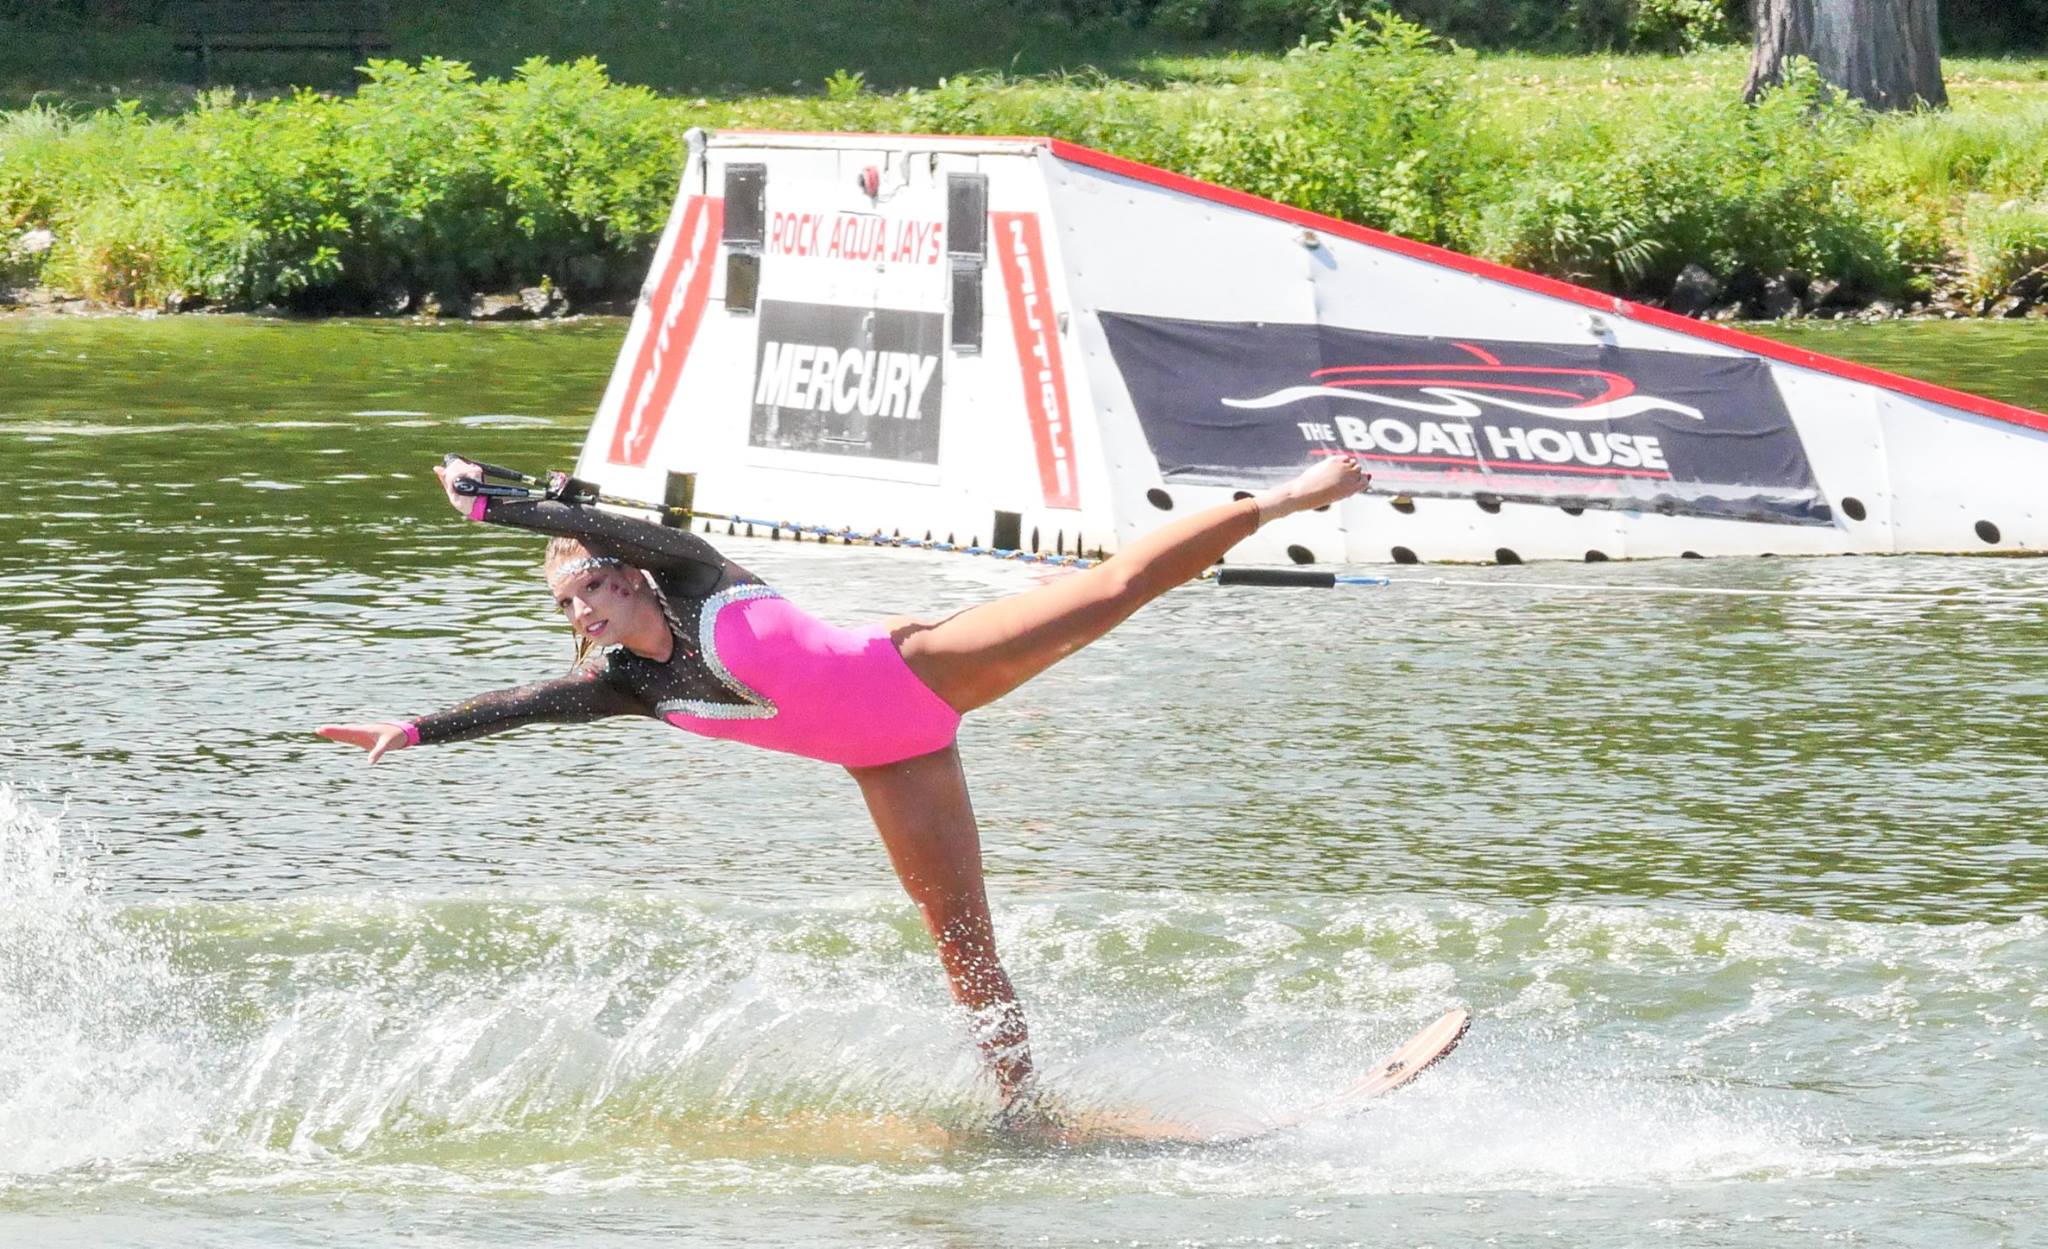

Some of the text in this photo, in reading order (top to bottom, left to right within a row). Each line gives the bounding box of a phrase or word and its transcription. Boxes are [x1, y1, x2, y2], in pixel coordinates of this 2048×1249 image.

[771, 211, 943, 265] ROCK AQUA JAYS
[755, 341, 939, 420] MERCURY
[1297, 415, 1669, 470] THE BOAT HOUSE
